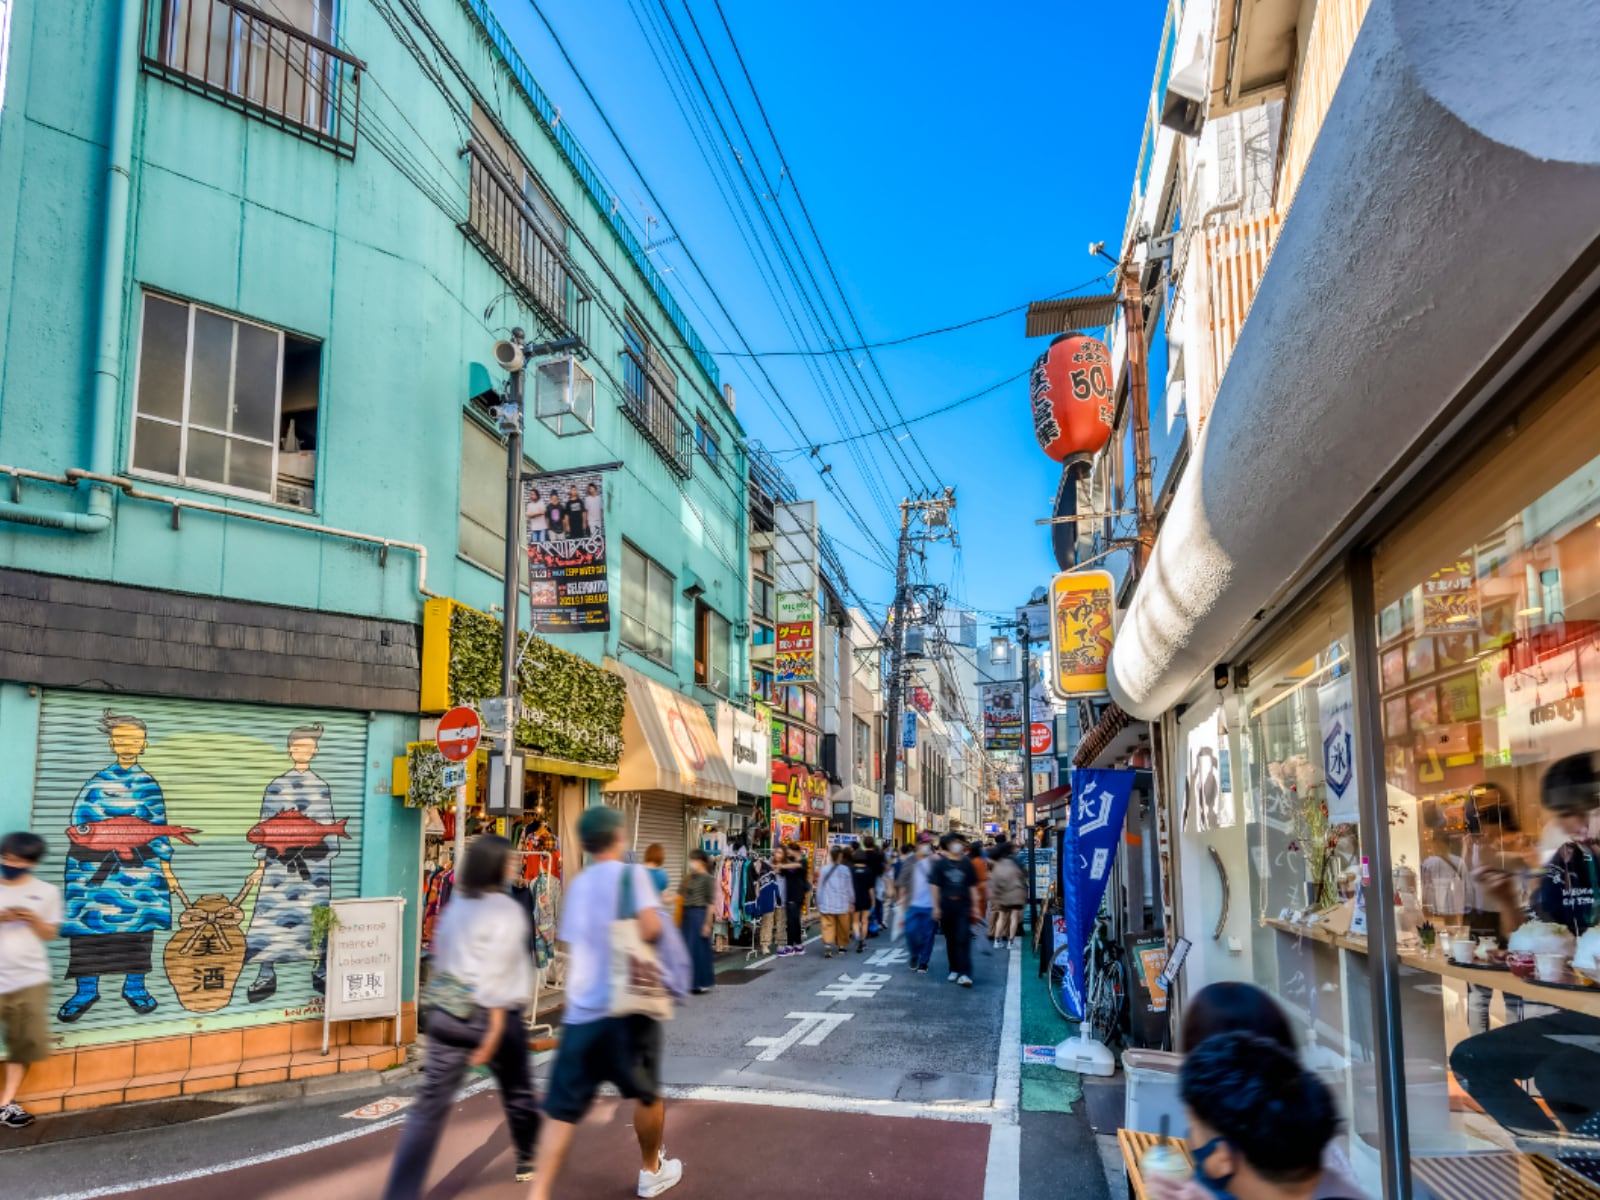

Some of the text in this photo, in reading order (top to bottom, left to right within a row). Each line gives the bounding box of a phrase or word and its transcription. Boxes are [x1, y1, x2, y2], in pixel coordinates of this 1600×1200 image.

[779, 625, 811, 638] ゲーム
[1330, 741, 1346, 775] 氷
[338, 935, 379, 950] marcel
[192, 934, 225, 991] 美酒
[346, 972, 382, 991] 買取
